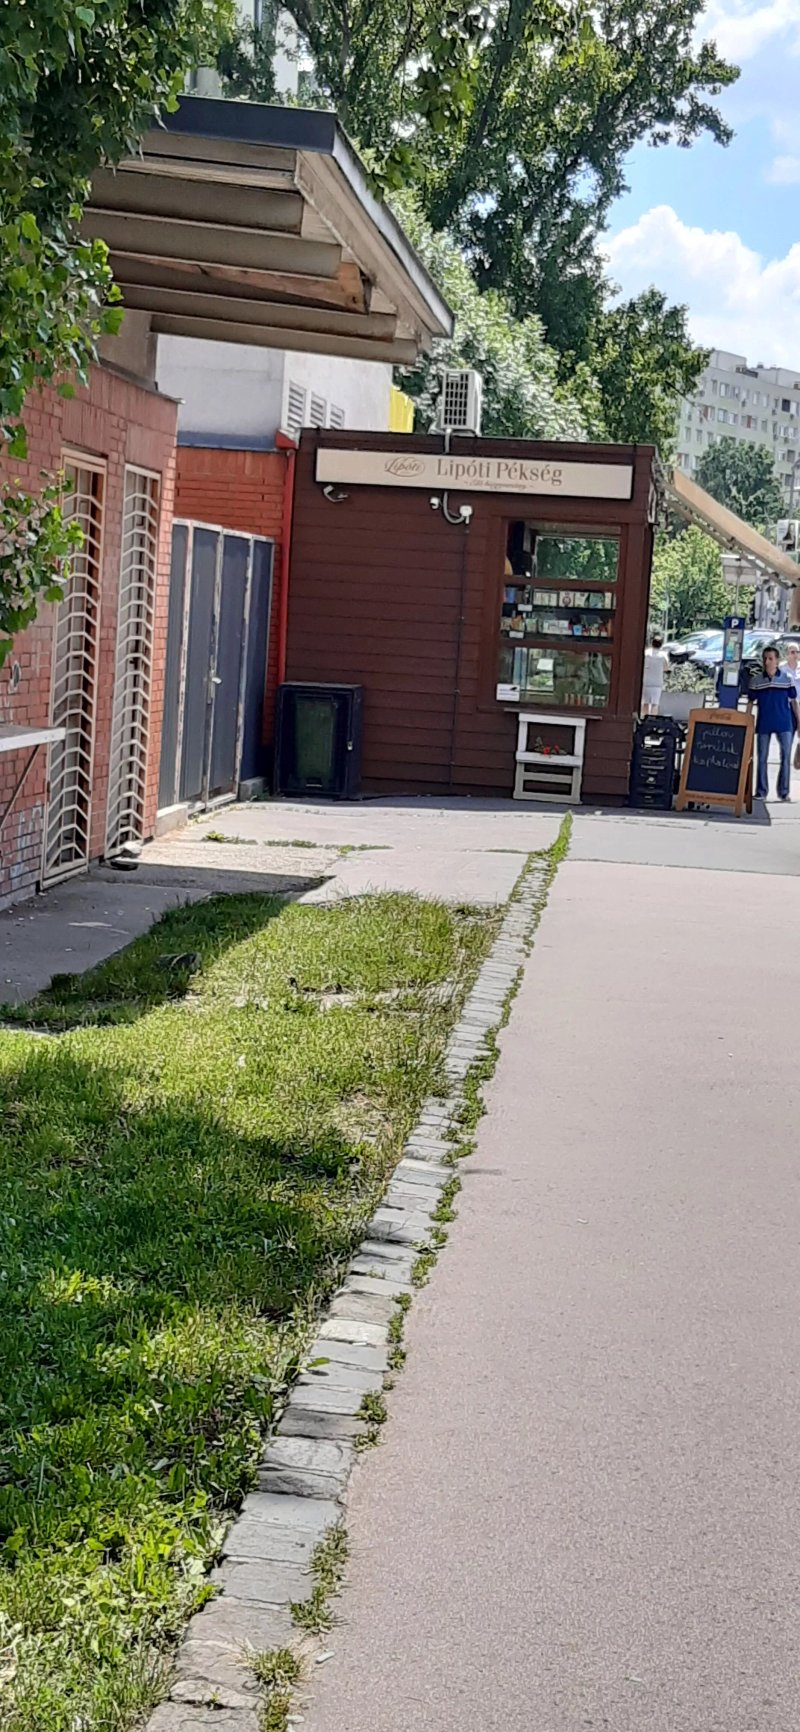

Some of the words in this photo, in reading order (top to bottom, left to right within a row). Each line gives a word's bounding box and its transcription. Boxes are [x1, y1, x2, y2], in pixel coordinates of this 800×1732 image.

[437, 459, 491, 480] Lipóti
[496, 461, 563, 487] Pékség
[731, 618, 739, 629] P
